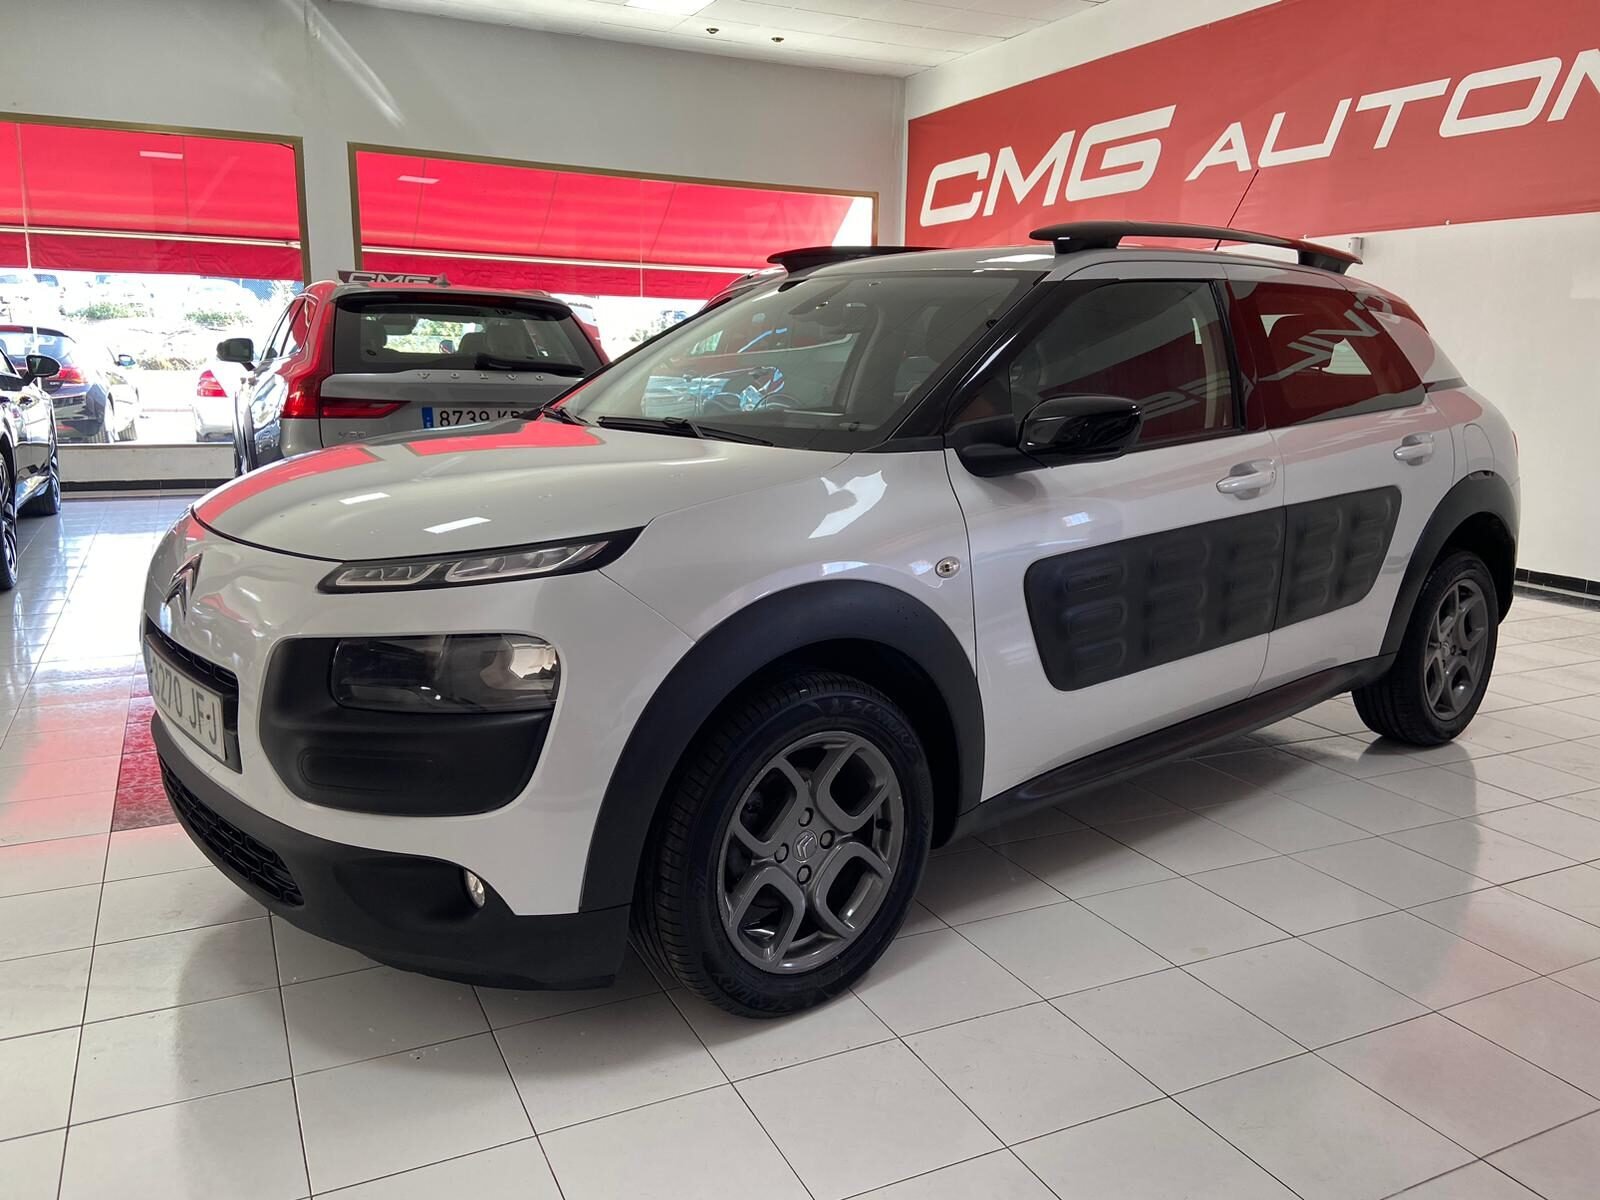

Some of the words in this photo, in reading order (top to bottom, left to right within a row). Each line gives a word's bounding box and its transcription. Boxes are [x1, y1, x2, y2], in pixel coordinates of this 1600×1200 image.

[919, 105, 1176, 228] CMG
[348, 273, 431, 284] CMG
[417, 371, 544, 382] VOLVO
